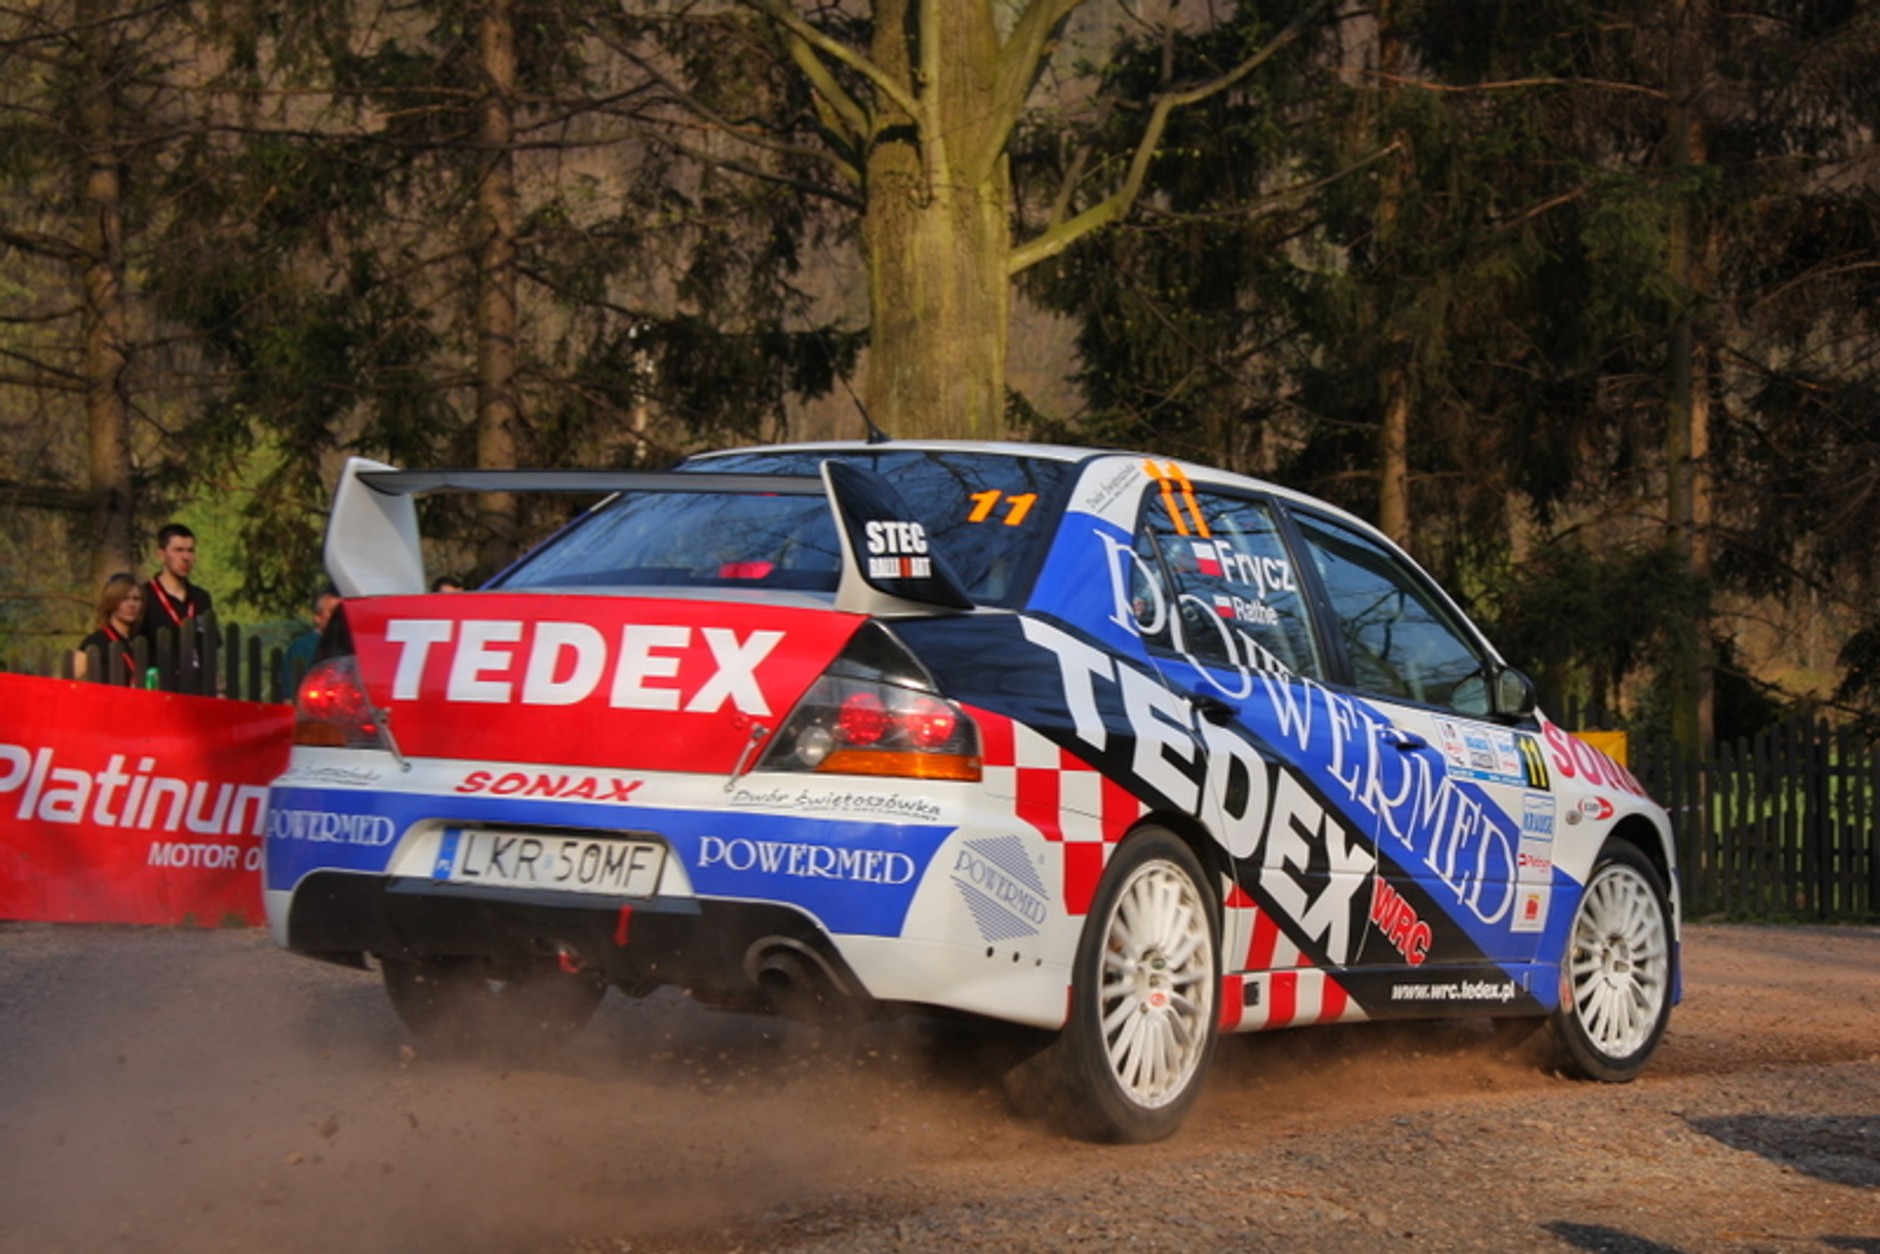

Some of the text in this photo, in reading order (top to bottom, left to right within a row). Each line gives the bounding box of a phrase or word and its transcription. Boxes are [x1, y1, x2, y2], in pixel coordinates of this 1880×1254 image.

[966, 489, 1039, 527] 11
[1143, 458, 1212, 539] 11
[865, 520, 929, 554] STEC
[1212, 539, 1298, 600] Frycz
[385, 618, 787, 717] TEDEX
[1093, 527, 1518, 926] POWERMED
[454, 770, 645, 802] SONAX
[1518, 737, 1549, 788] 11
[1018, 613, 1378, 972] TEDEX
[147, 841, 240, 870] MOTOR
[461, 833, 656, 888] LKR 50MF
[696, 835, 915, 885] POWERMED
[953, 849, 1048, 925] POWERMED
[1370, 876, 1432, 967] WRC
